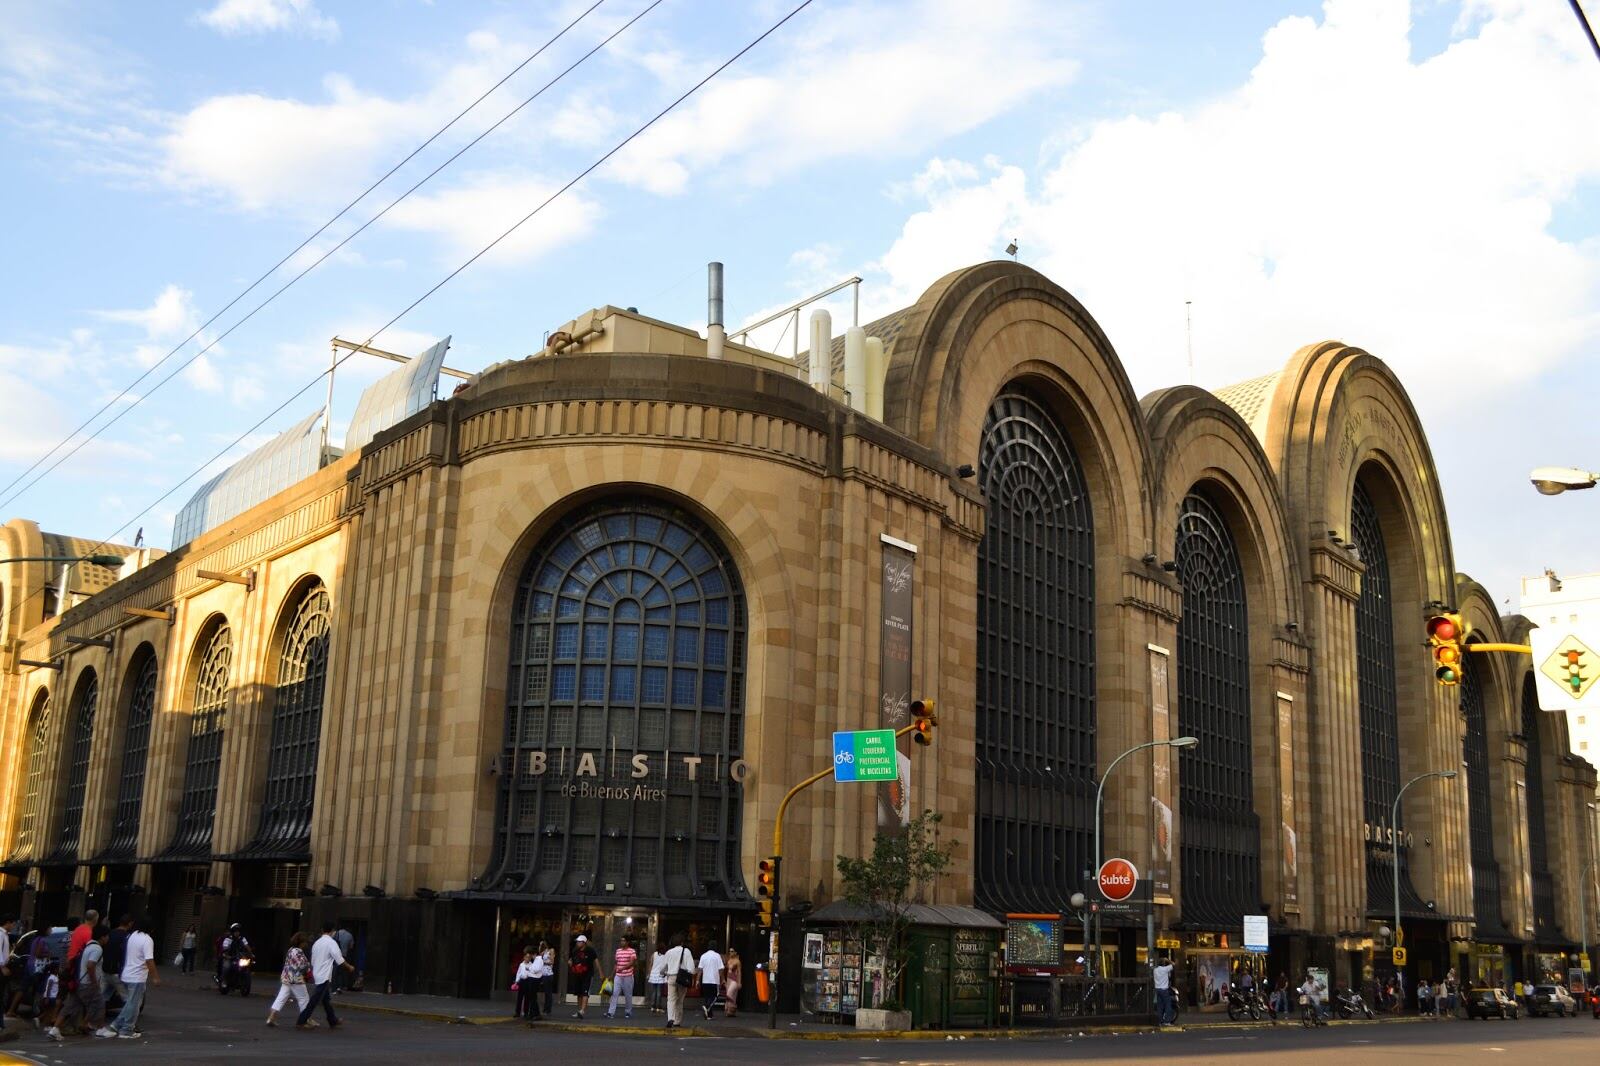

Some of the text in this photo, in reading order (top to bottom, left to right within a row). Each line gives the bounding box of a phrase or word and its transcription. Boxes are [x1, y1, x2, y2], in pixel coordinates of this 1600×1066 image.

[885, 619, 909, 631] RIVER PLATE
[865, 737, 881, 745] CARRIL
[862, 747, 886, 755] IZQUIERDO
[859, 757, 890, 765] PREFERENCIAL
[487, 751, 751, 783] ABASTO
[860, 767, 892, 775] DE BICICLETAS
[561, 781, 666, 801] de Buenos Aires
[1364, 823, 1413, 848] BASTO
[1101, 874, 1131, 885] Subte
[1395, 950, 1403, 960] 9
